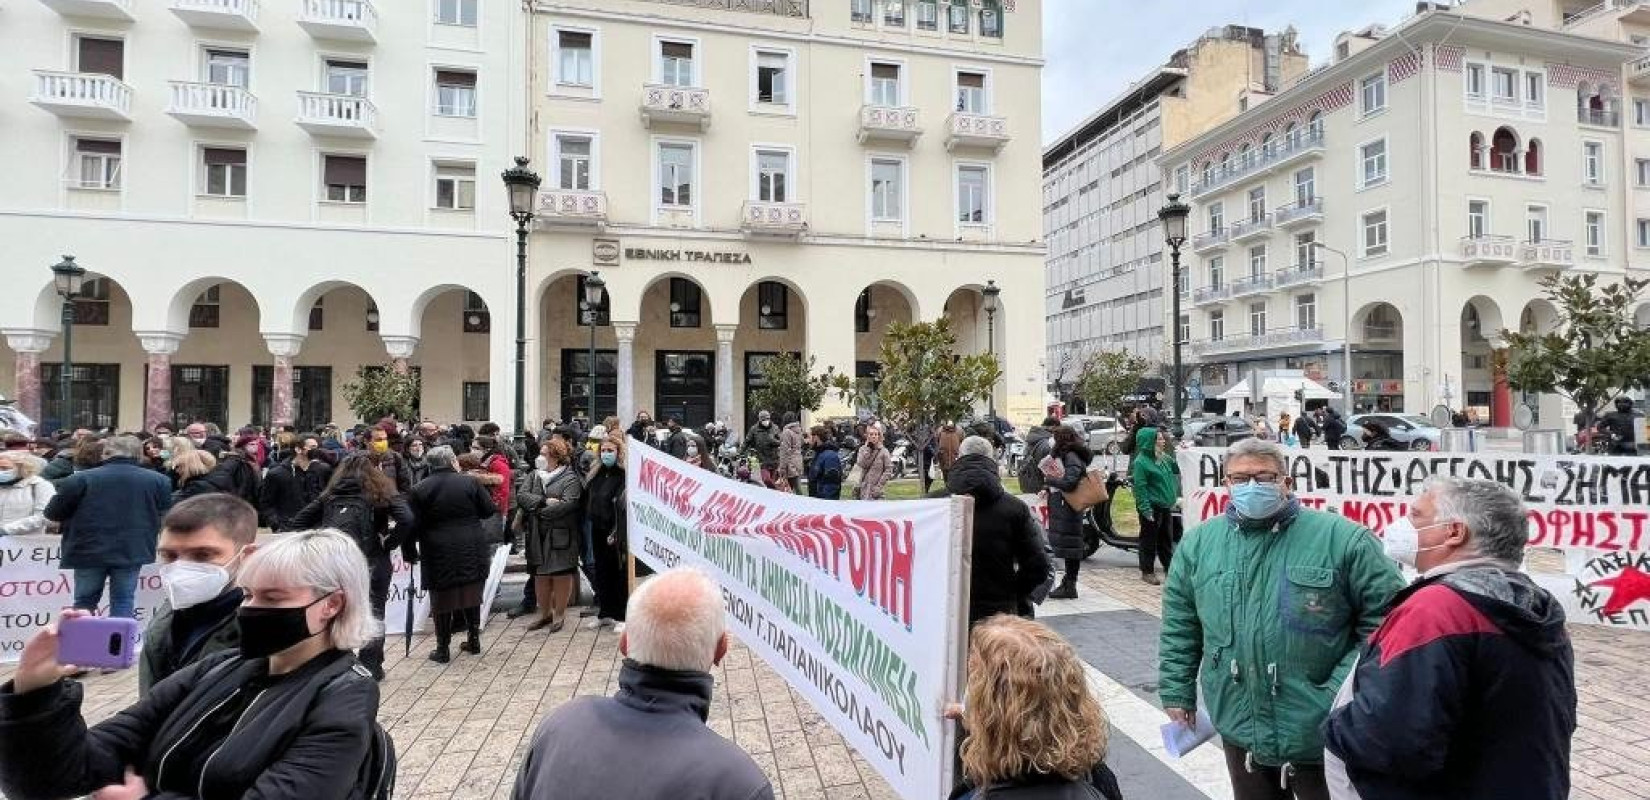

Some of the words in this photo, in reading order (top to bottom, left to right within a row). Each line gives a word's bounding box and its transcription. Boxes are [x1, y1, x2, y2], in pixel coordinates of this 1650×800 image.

[625, 248, 680, 260] ΕΘΝΙΚΗ
[685, 251, 751, 264] ΤΡΑΠΕΖΑ
[1329, 456, 1394, 496] ΤΗΣ
[1526, 509, 1650, 550] ΟΦΗΣΤ
[1572, 578, 1650, 625] ΑΝΤΕΠ
[760, 556, 814, 635] ΔΗΜΟΣΙΑ
[814, 589, 930, 752] ΝΟΣΟΚΟΜΕΙΑ
